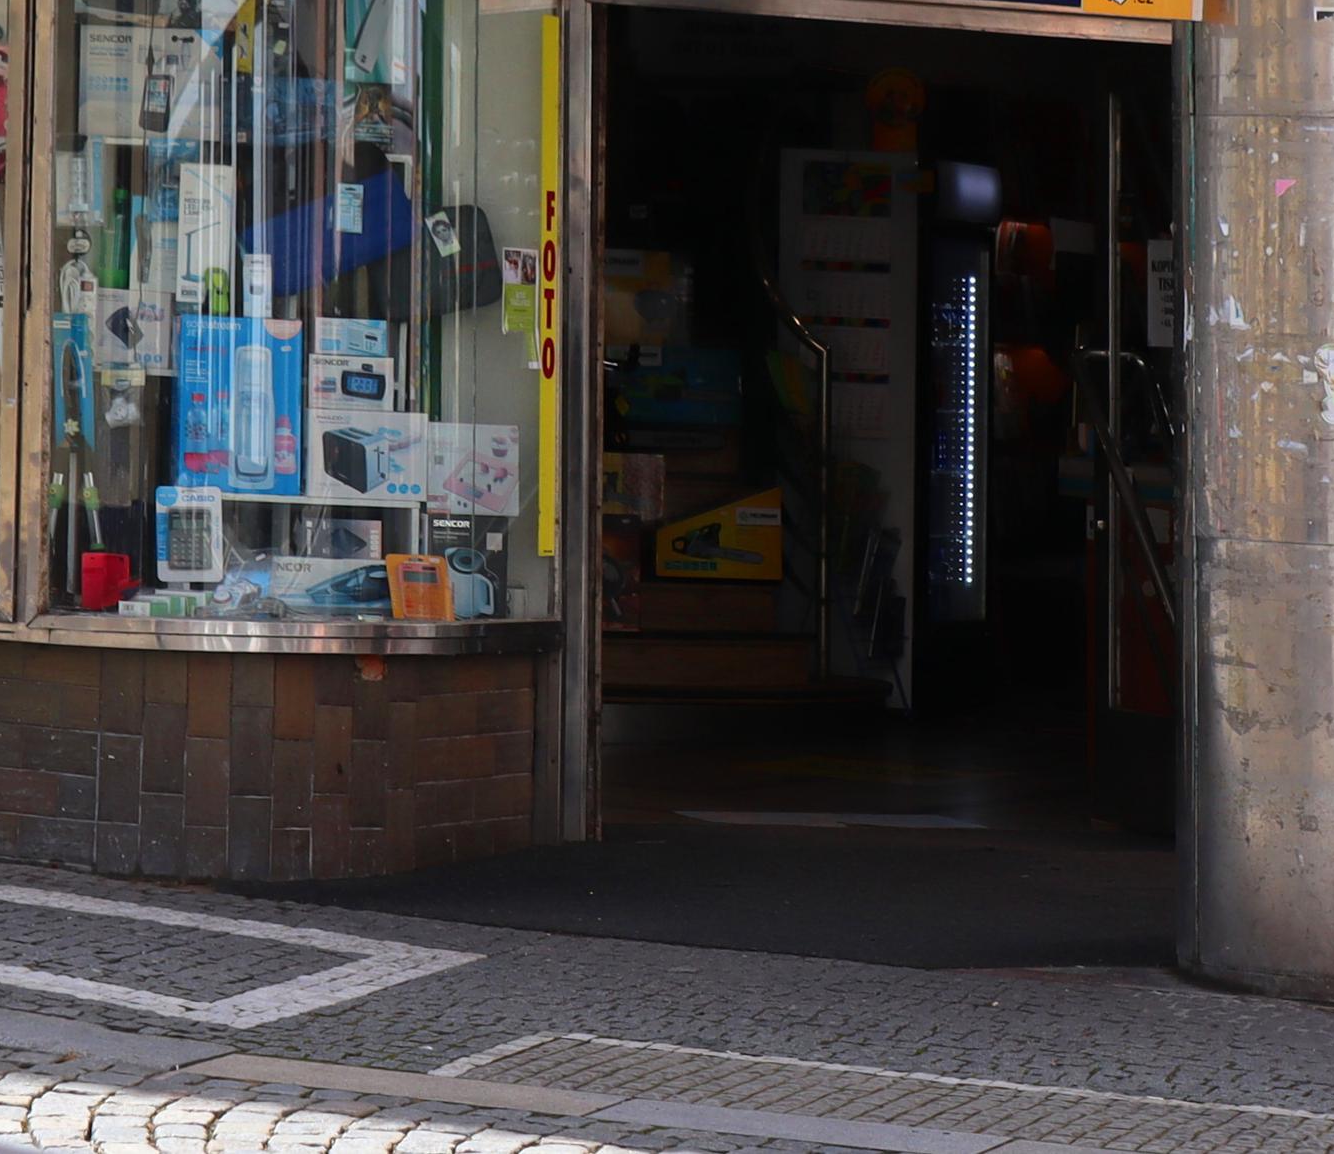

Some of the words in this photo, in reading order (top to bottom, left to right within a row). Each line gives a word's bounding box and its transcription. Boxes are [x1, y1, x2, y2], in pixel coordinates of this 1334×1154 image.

[543, 190, 557, 380] FOTO
[313, 358, 350, 367] SENCOR
[181, 494, 216, 503] CASIO
[433, 519, 471, 528] SENCOR
